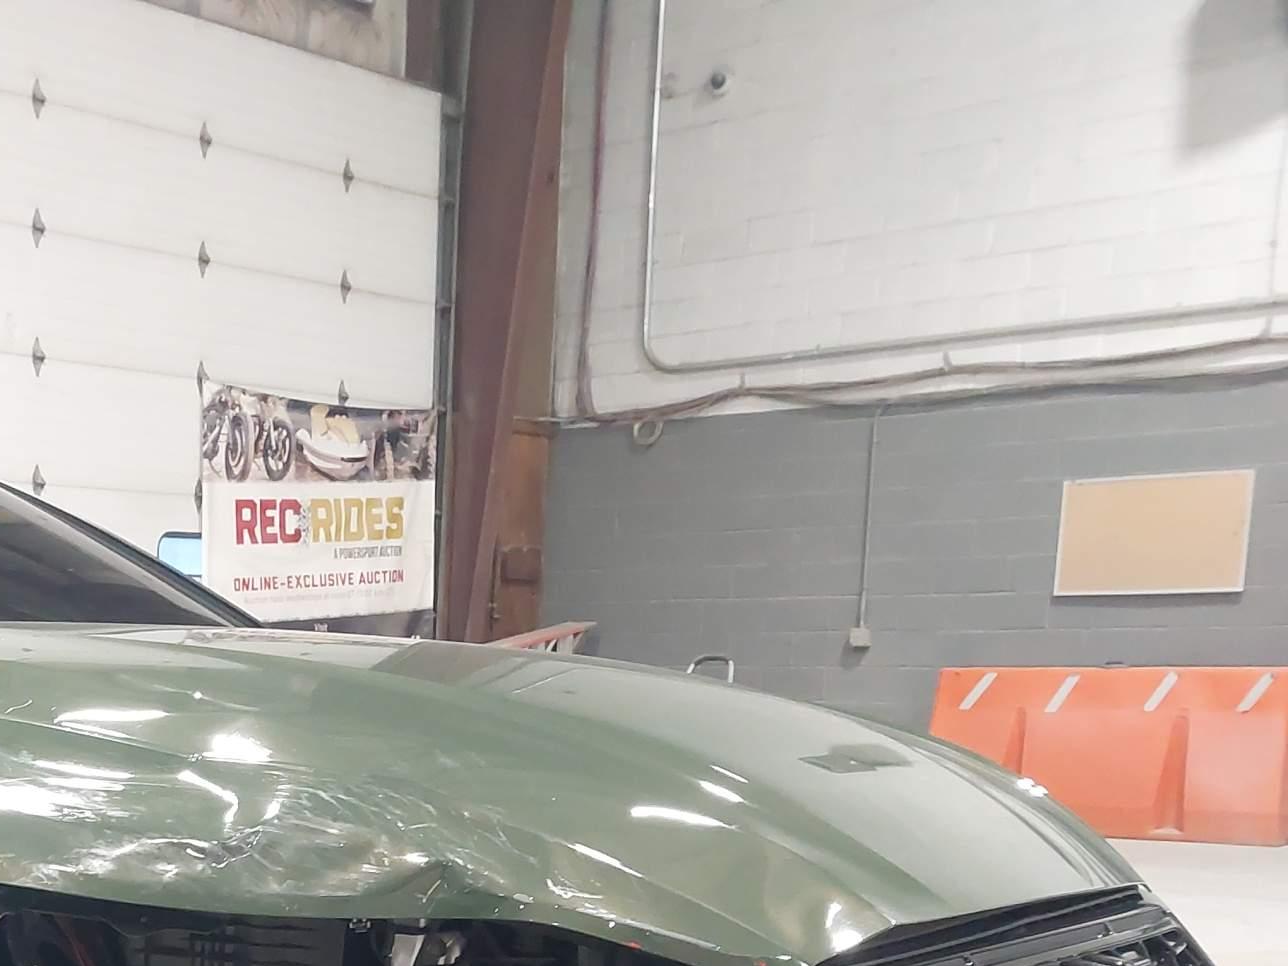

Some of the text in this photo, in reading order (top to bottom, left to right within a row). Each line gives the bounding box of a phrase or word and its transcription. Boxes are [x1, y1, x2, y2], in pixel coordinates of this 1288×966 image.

[235, 496, 405, 545] REC RIDES
[233, 569, 404, 592] ONLINE-EXCLUSIVE AUCTION
